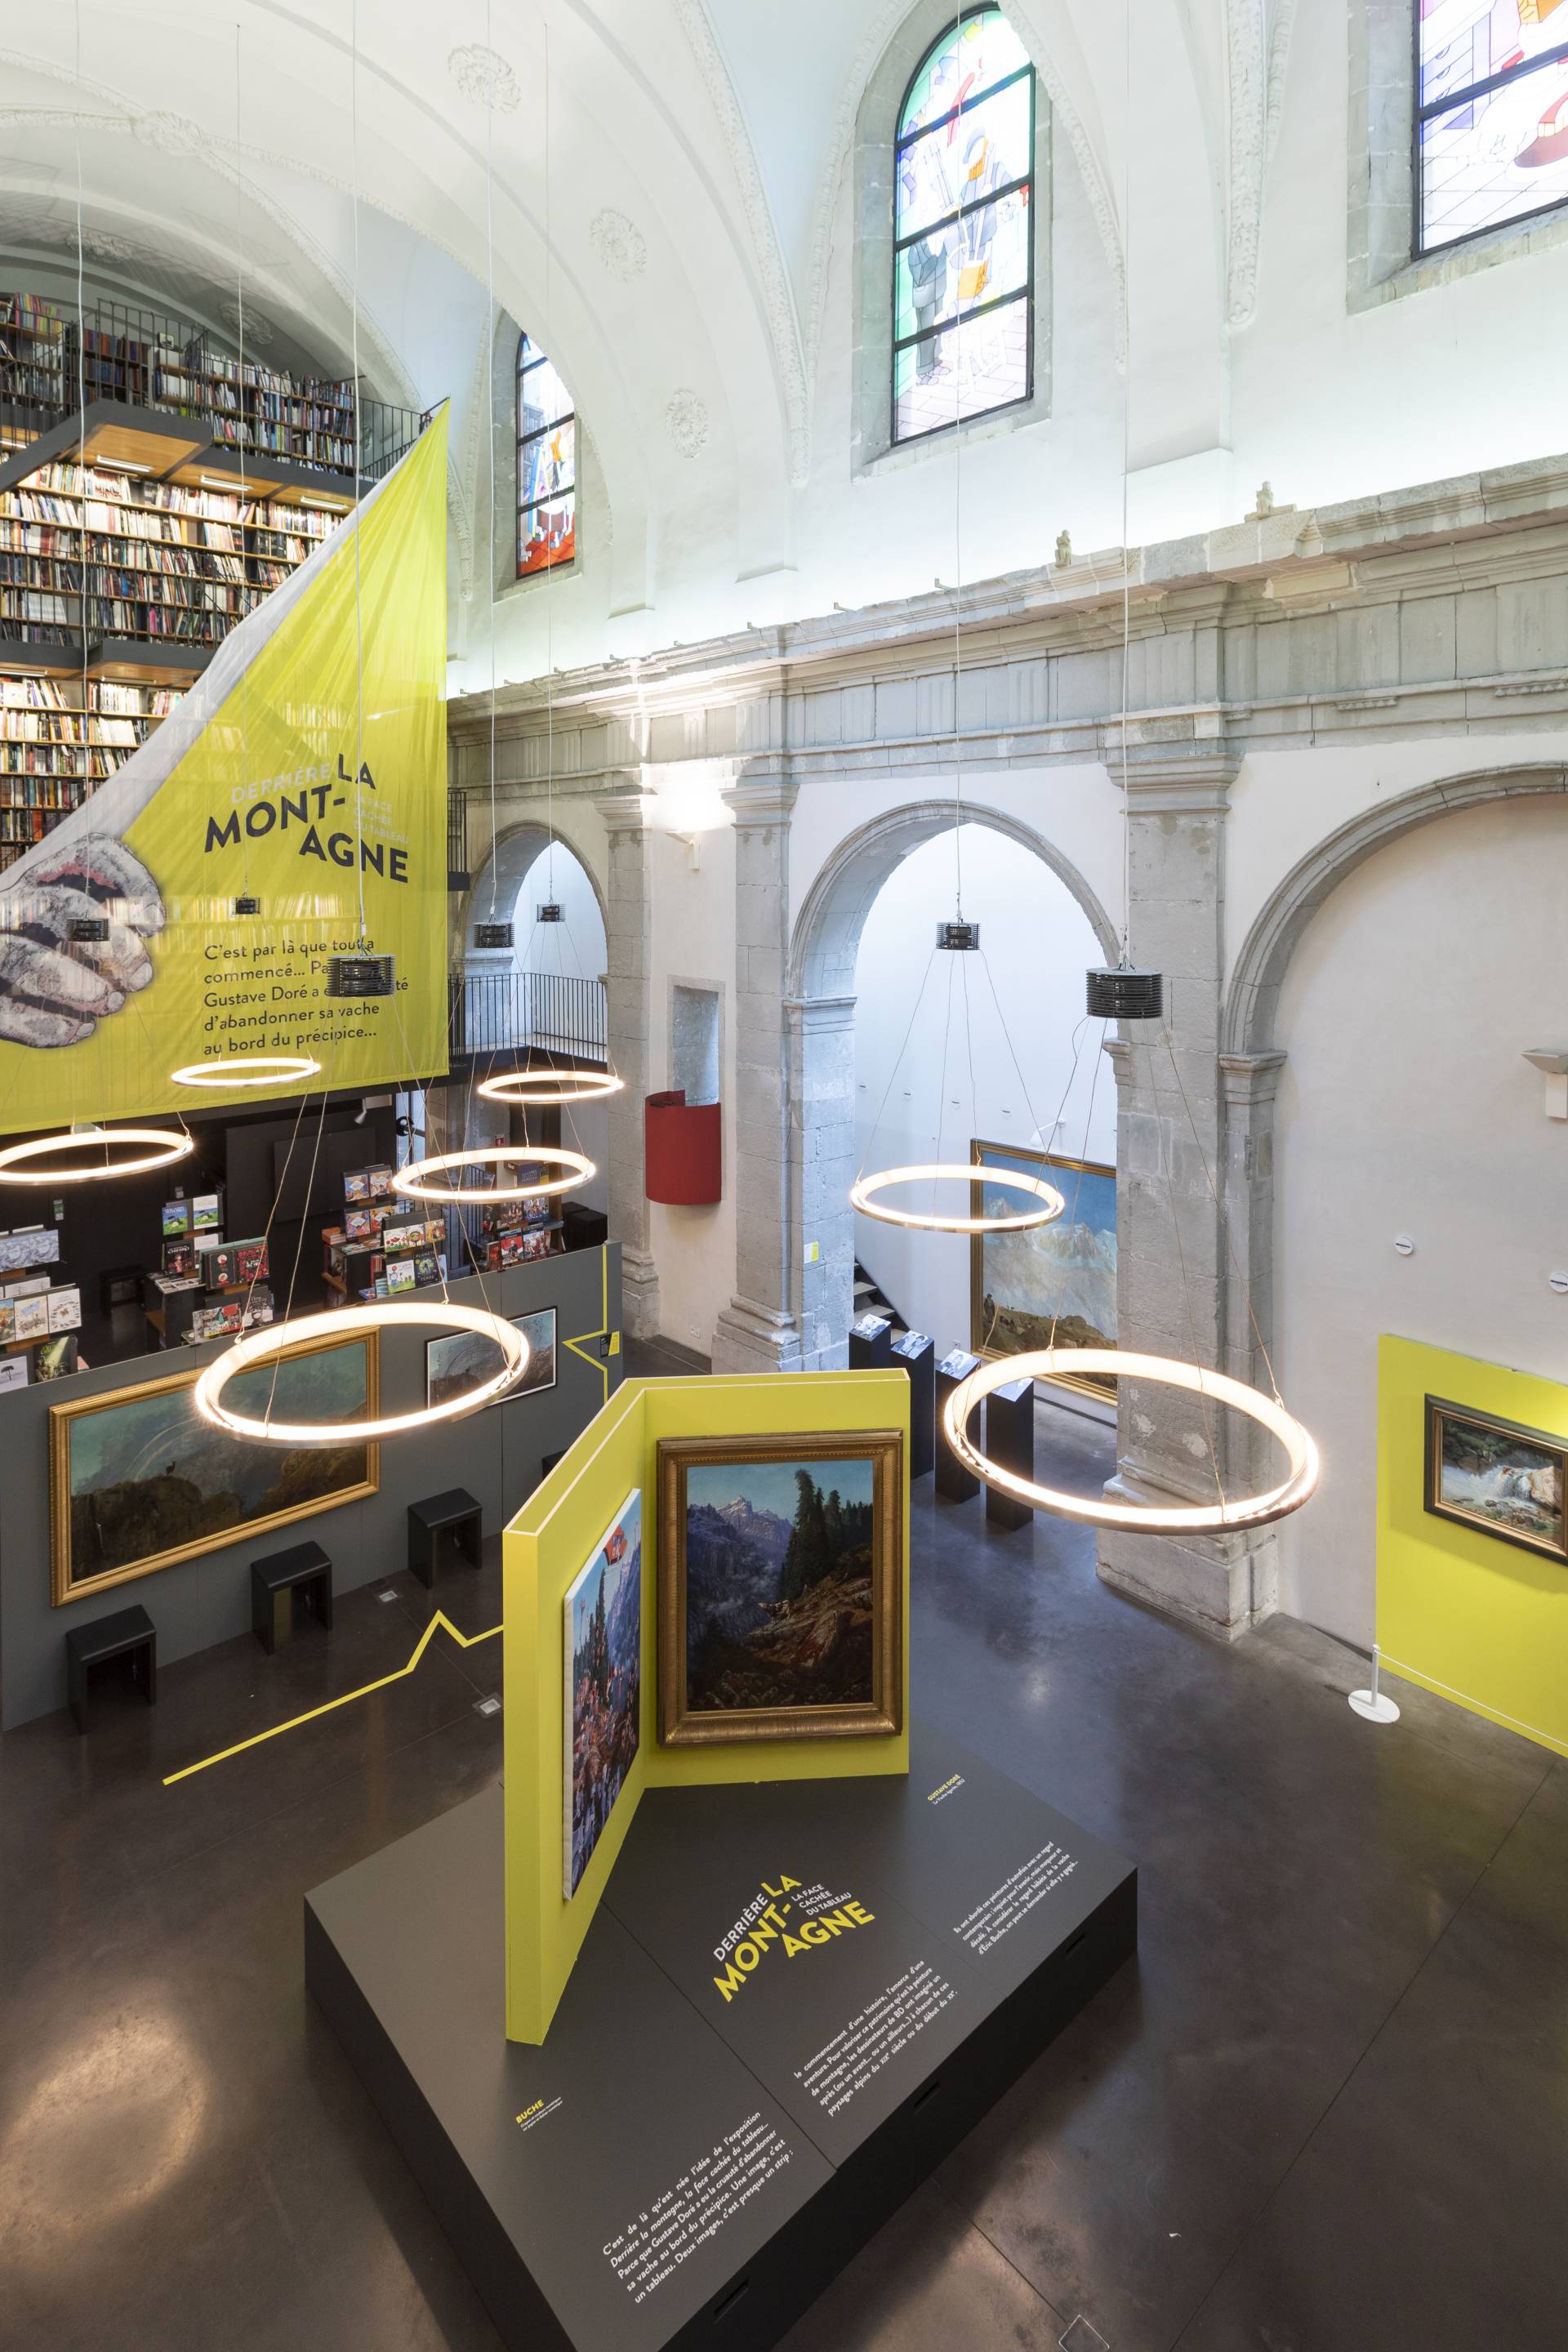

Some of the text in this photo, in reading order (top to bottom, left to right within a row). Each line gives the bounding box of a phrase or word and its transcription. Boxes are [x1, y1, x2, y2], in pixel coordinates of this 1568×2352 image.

[338, 754, 376, 790] LA
[204, 784, 345, 853] MONT-
[299, 825, 408, 883] AGNE
[204, 939, 374, 961] C'est par là que tout a
[204, 963, 305, 984] commencé...
[204, 991, 266, 1008] Gustave
[271, 984, 307, 1001] Doré
[312, 987, 319, 997] a
[204, 1001, 380, 1031] d'abandonner sa vache
[204, 1026, 376, 1055] au bord du précipice...
[928, 1784, 949, 1800] GUSTAVE
[791, 1883, 824, 1901] LA FACE
[799, 1891, 832, 1908] CACHÉE
[806, 1892, 851, 1916] DU TABLEAU
[714, 1875, 802, 1962] DERRIÈRE LA
[782, 1901, 875, 1958] AGNE
[714, 1903, 791, 2002] MONT-
[516, 2100, 544, 2123] BUCHE
[603, 2112, 761, 2256] C'est de là qu'est née l'idée de l'exposition
[610, 2239, 640, 2269] Derrière
[639, 2231, 649, 2241] la
[684, 2190, 693, 2199] la
[693, 2176, 709, 2194] face
[710, 2155, 732, 2177] cachée
[732, 2146, 742, 2156] du
[617, 2259, 639, 2280] Parce
[639, 2247, 653, 2262] que
[651, 2221, 679, 2247] Gustave
[677, 2204, 696, 2224] Doré
[701, 2193, 710, 2203] eu
[707, 2187, 716, 2195] la
[715, 2164, 739, 2189] cruauté
[738, 2130, 777, 2167] d'abandonner
[626, 2281, 636, 2292] sa
[636, 2260, 659, 2282] vache
[659, 2249, 670, 2261] au
[668, 2230, 688, 2251] bord
[688, 2221, 699, 2234] du
[730, 2176, 747, 2191] Une
[769, 2139, 786, 2156] c'est
[635, 2292, 646, 2304] un
[674, 2243, 697, 2264] Deux
[723, 2201, 740, 2219] c'est
[739, 2176, 765, 2206] presque
[764, 2167, 775, 2179] un
[774, 2154, 790, 2170] strip
